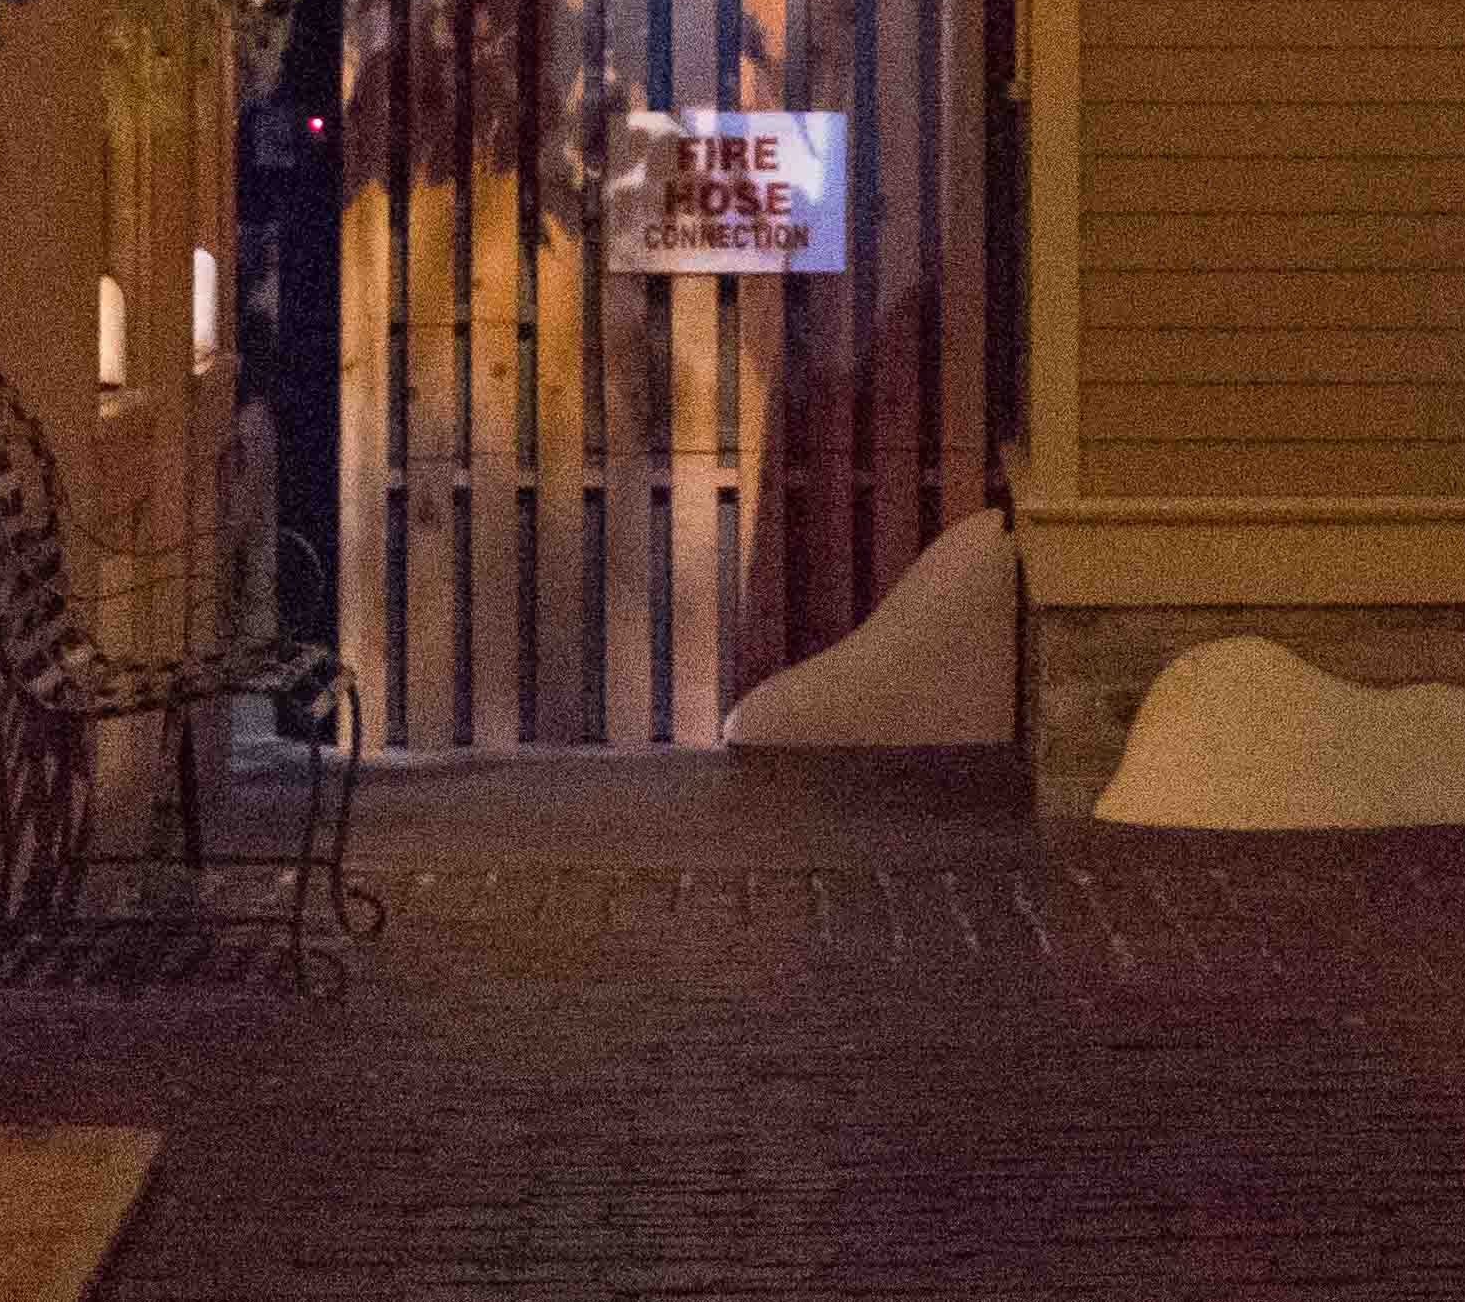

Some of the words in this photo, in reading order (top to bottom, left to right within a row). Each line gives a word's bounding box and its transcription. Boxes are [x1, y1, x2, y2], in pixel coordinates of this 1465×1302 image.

[677, 136, 778, 171] FIRE
[665, 181, 792, 216] HOSE
[644, 223, 810, 250] CONNECTION
